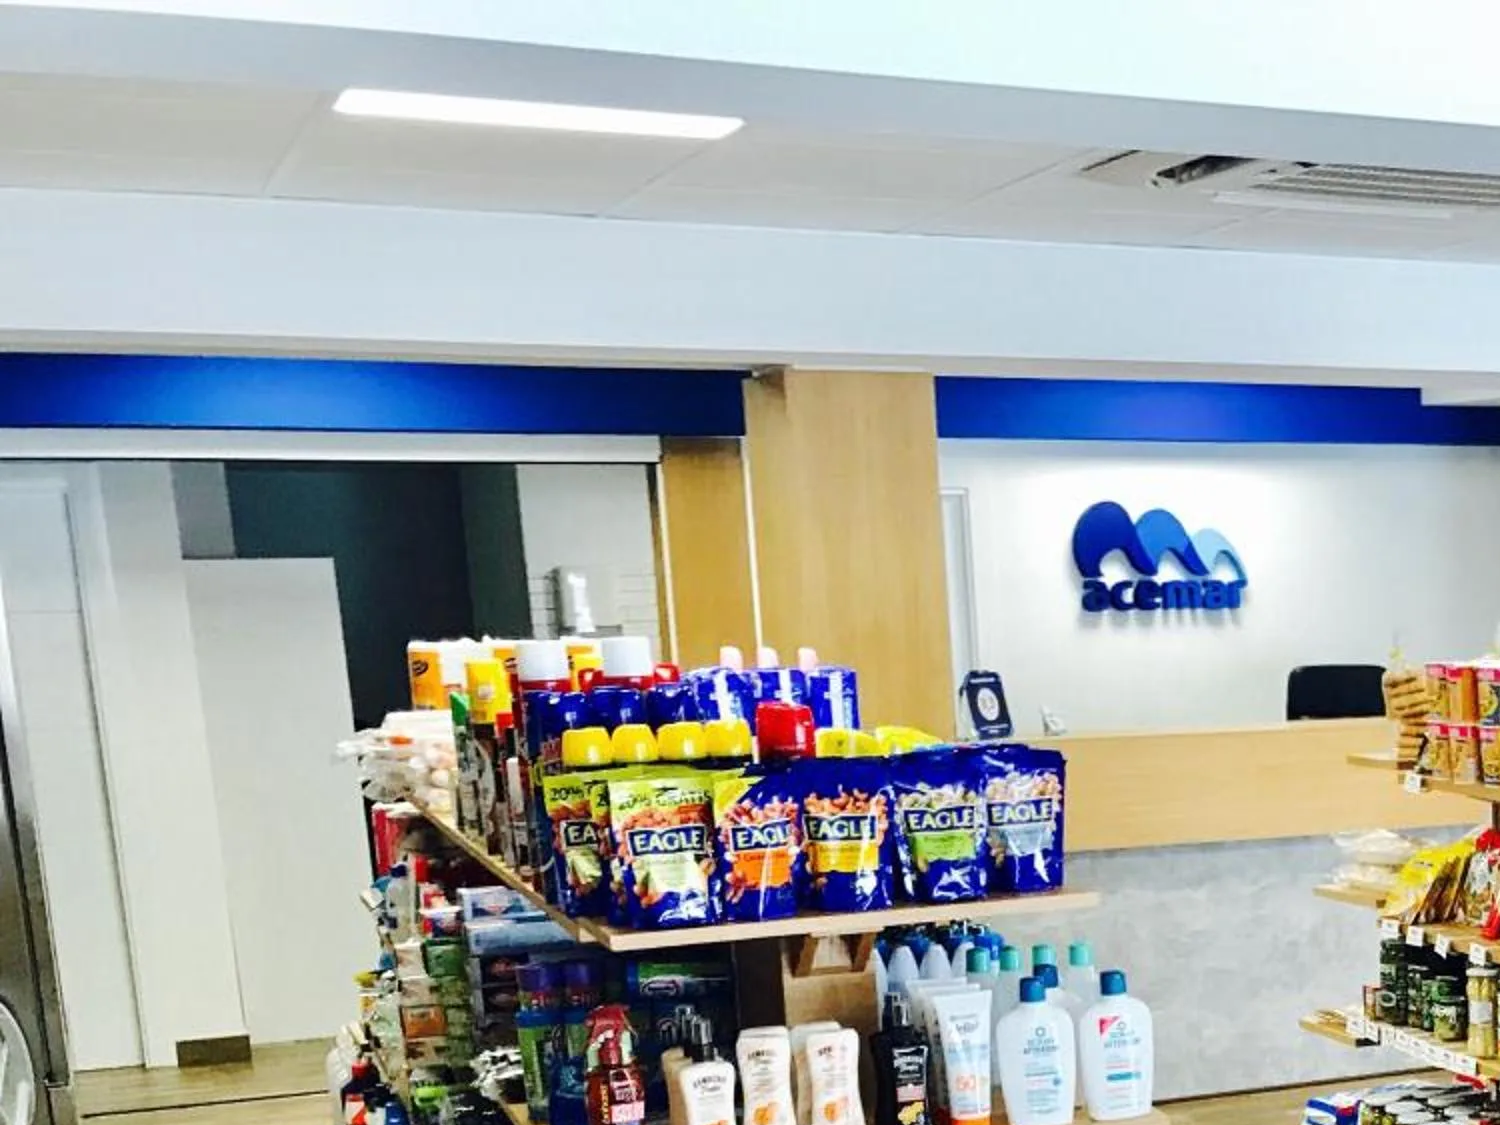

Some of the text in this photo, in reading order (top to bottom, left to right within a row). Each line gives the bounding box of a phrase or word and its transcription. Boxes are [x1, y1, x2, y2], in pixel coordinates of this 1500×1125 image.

[1081, 579, 1247, 611] acemar
[907, 809, 975, 830] EAGLE
[990, 801, 1053, 822] EAGLE
[634, 830, 701, 853] EAGLE
